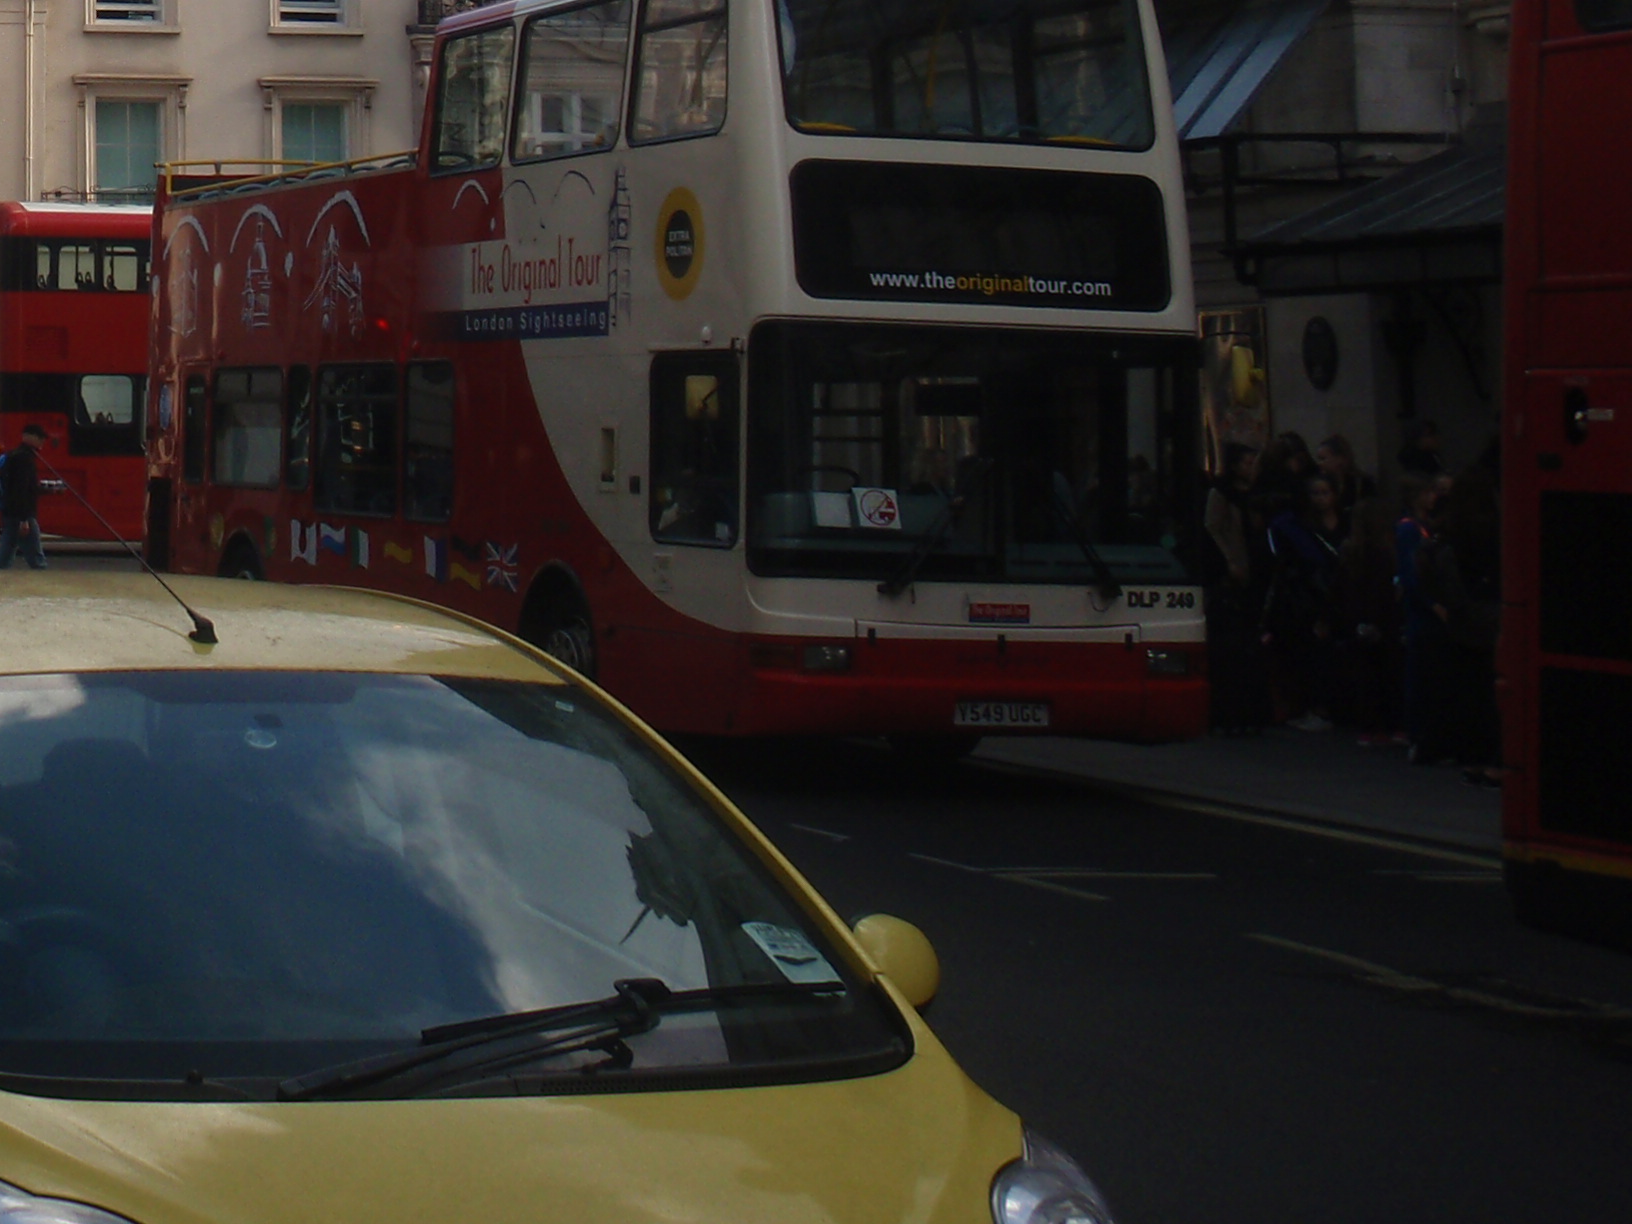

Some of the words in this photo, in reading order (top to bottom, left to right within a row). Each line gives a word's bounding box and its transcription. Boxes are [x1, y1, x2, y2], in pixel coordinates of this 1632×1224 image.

[471, 244, 495, 295] The
[501, 234, 562, 305] Original
[568, 238, 603, 287] Tour
[868, 270, 1113, 297] www.theoriginaltour.com
[464, 314, 513, 332] London
[519, 308, 607, 334] Sightseeing
[1127, 590, 1160, 608] DLP
[956, 702, 1004, 723] Y549
[1008, 703, 1042, 723] UGC
